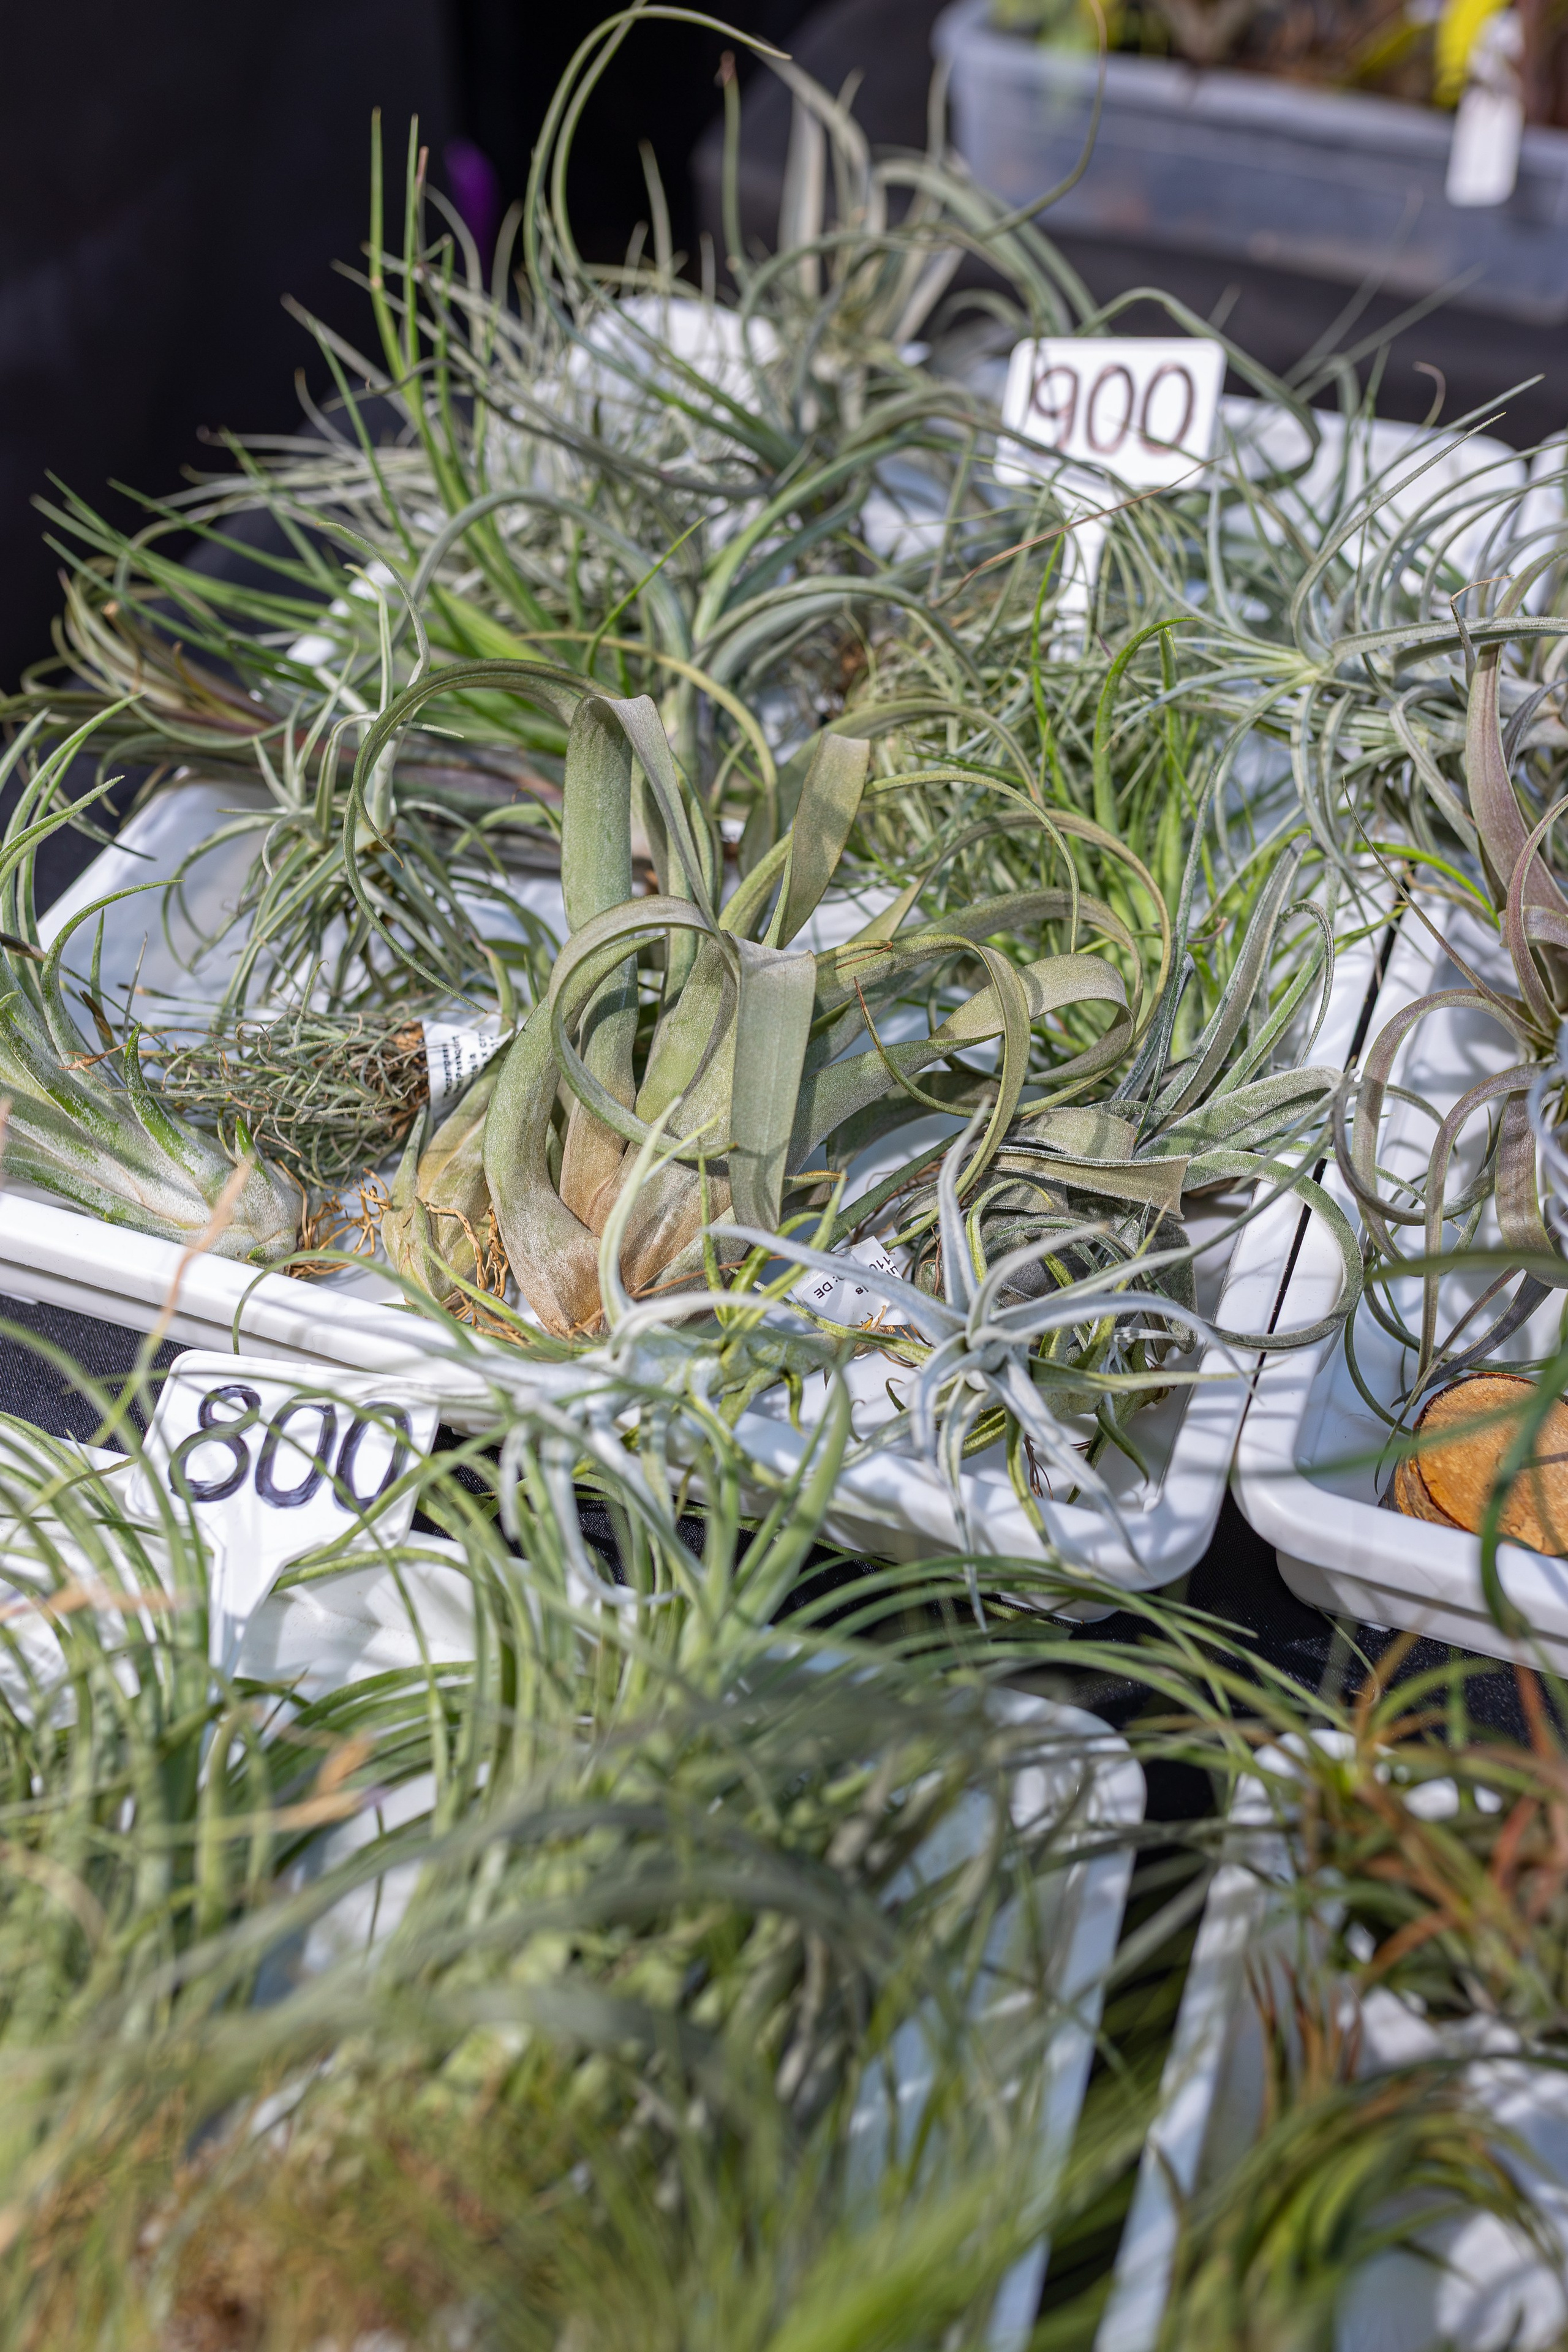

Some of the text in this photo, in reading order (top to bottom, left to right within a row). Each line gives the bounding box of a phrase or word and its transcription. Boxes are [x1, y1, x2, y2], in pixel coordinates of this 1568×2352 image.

[1034, 364, 1195, 457] 900
[813, 1281, 834, 1299] DE
[168, 1384, 412, 1513] 800
